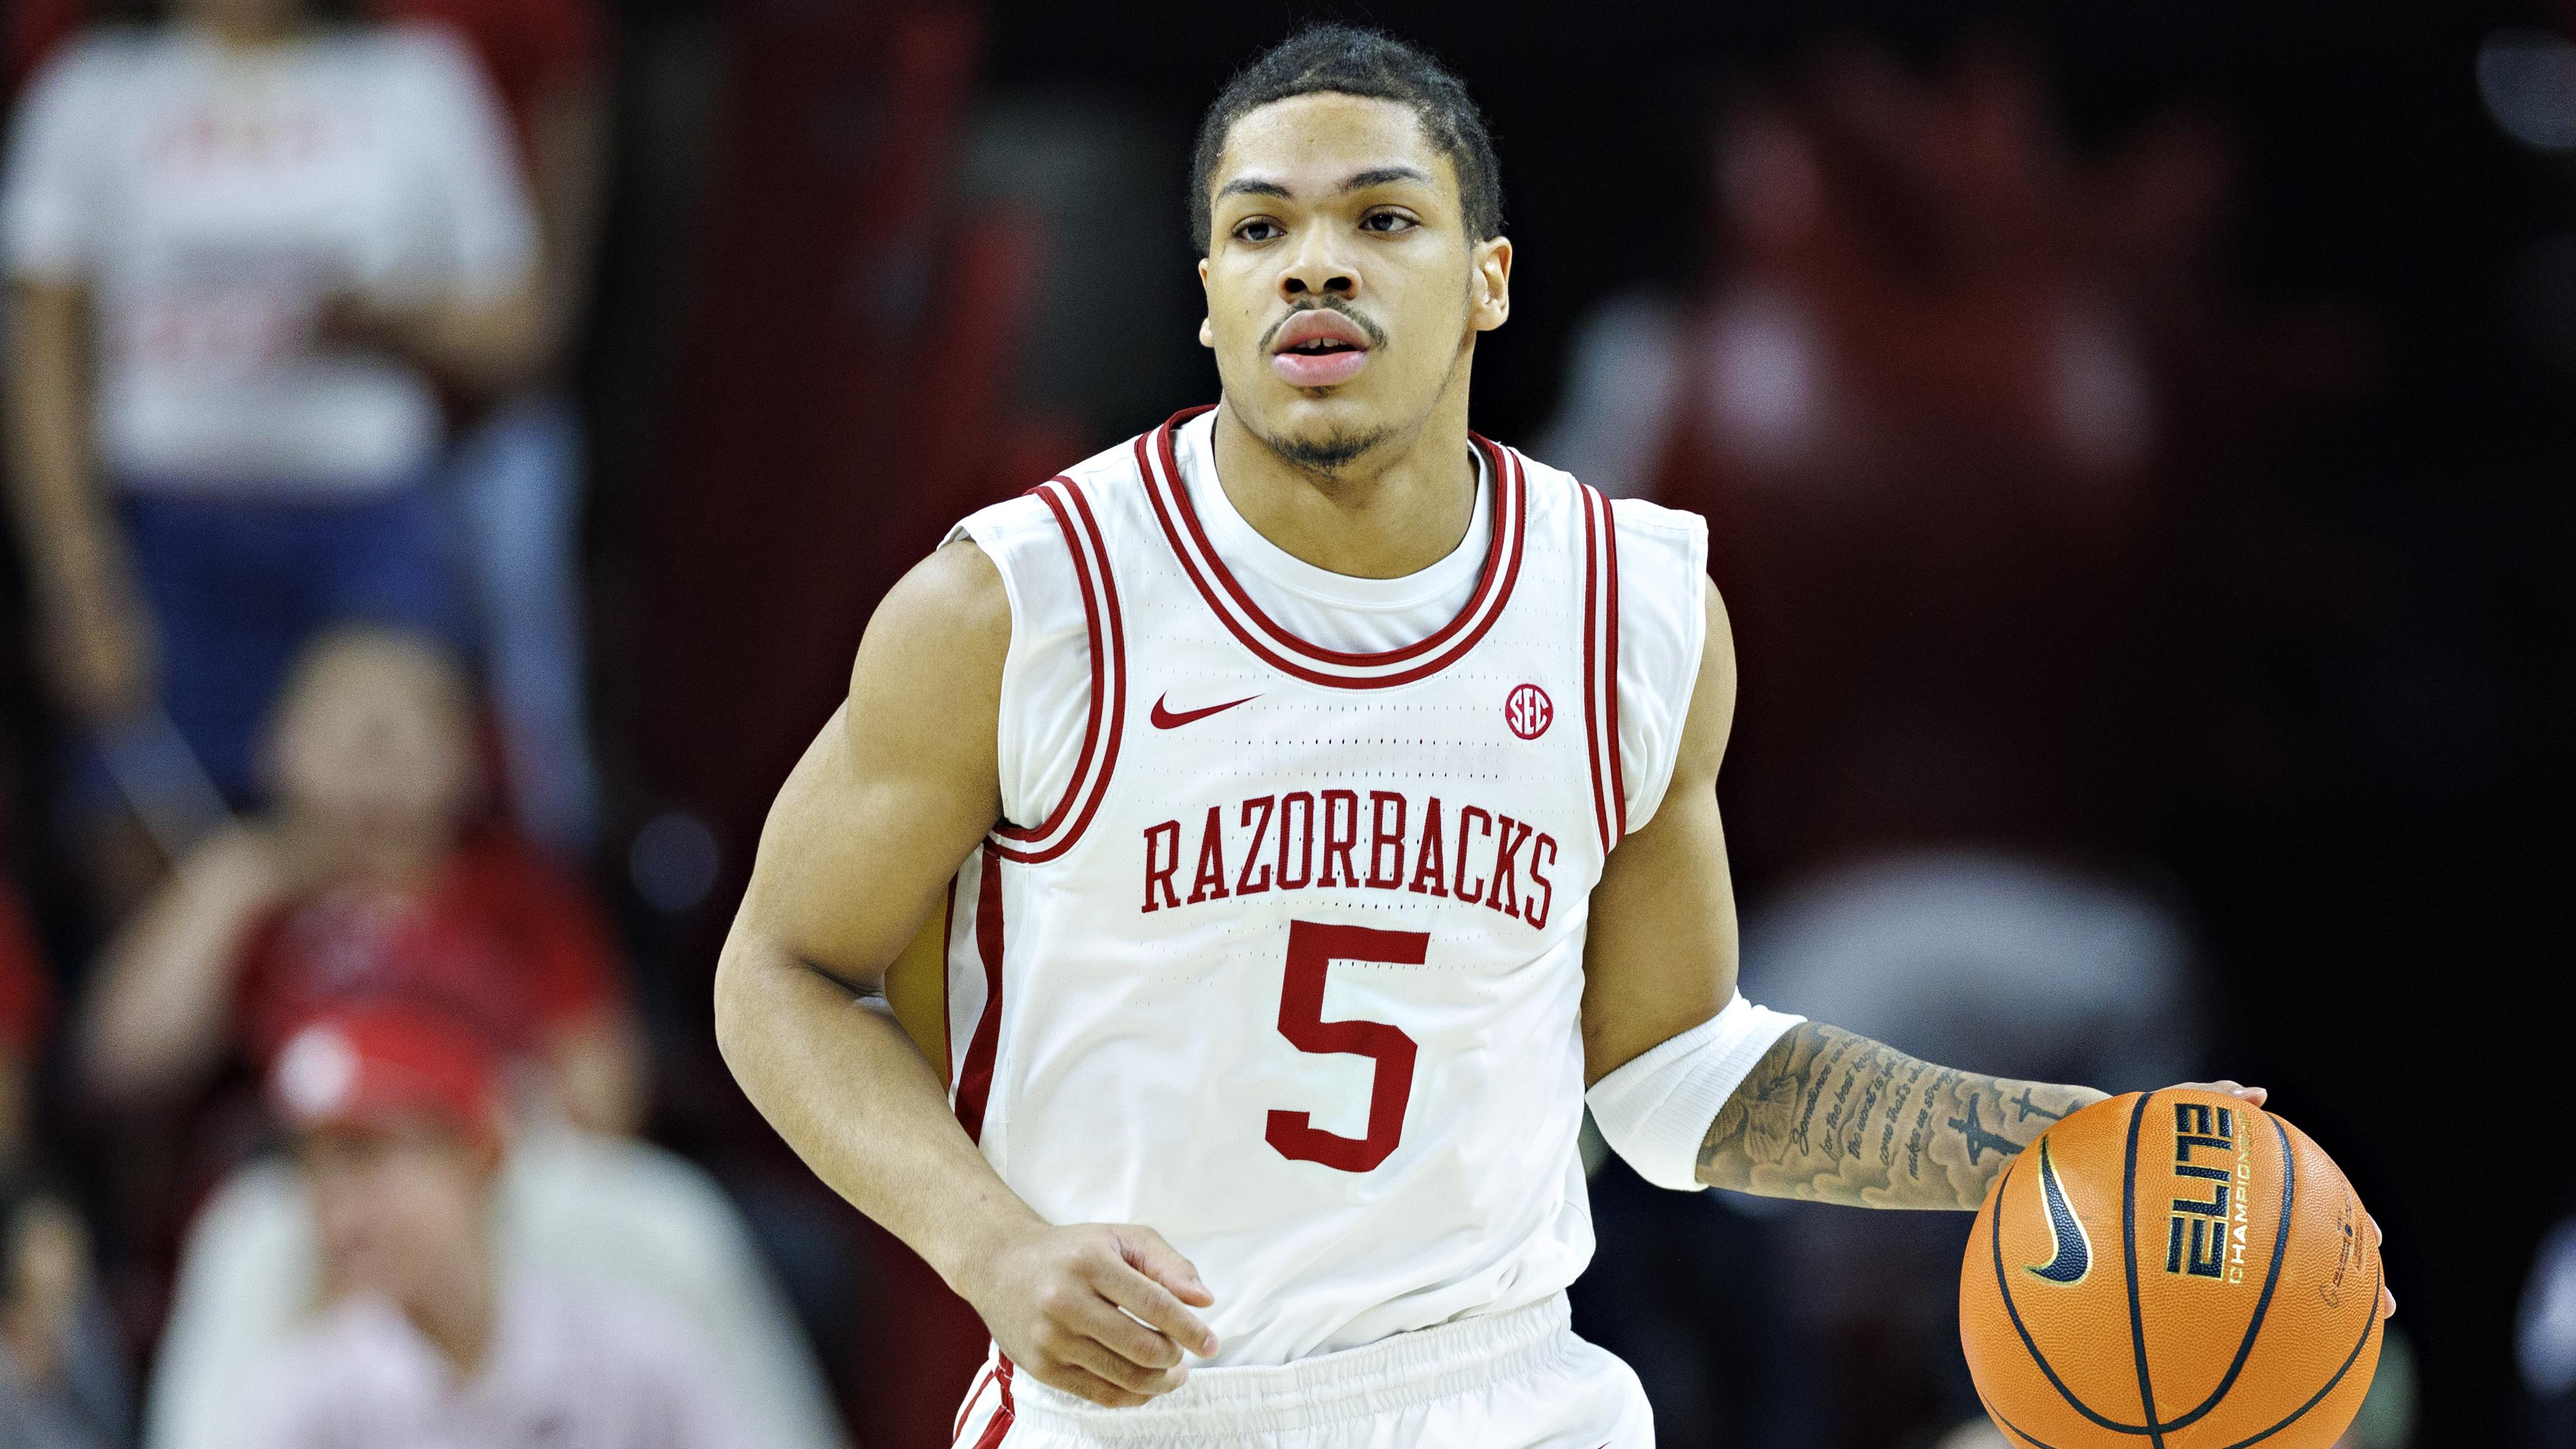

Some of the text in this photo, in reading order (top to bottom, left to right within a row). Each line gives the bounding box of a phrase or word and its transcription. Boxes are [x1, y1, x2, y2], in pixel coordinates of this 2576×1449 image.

[1509, 687, 1549, 735] SEC
[1141, 789, 1558, 930] RAZORBACKS
[1265, 919, 1431, 1173] 5
[1792, 1064, 1831, 1156] Sometimes
[1830, 1048, 1844, 1064] we
[1834, 1066, 1855, 1104] best
[1886, 1084, 1911, 1123] that's
[1819, 1128, 1839, 1162] for
[1827, 1104, 1842, 1130] the
[1847, 1132, 1862, 1160] the
[1857, 1080, 1876, 1132] worst
[1873, 1076, 1884, 1091] is
[1880, 1124, 1893, 1166] come
[1905, 1128, 1921, 1180] makes
[1917, 1108, 1929, 1129] us
[2165, 1103, 2234, 1281] ELITE
